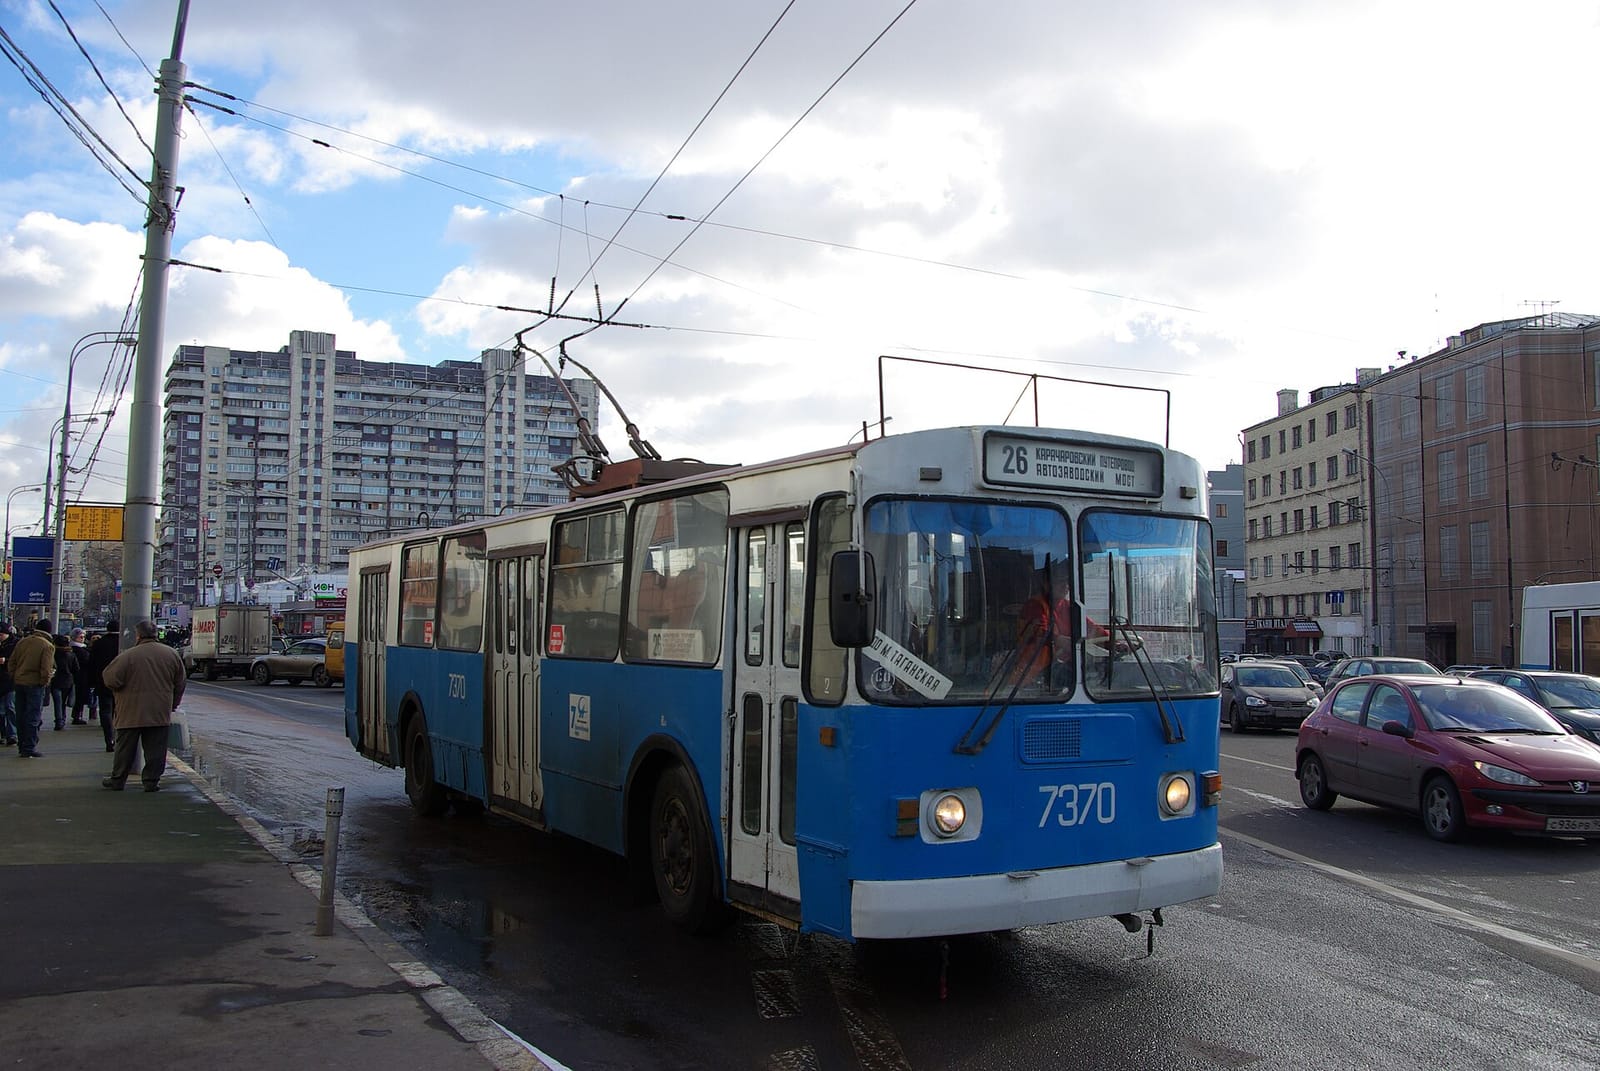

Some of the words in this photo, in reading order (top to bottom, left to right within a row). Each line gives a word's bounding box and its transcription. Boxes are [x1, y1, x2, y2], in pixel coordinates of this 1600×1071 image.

[1002, 445, 1028, 475] 26
[1035, 447, 1096, 467] КАРАЧАРОВСКИЙ
[1115, 472, 1135, 488] МОСТ
[449, 673, 466, 699] 7370
[890, 650, 940, 692] ТАГАНСКАЯ
[1038, 782, 1115, 828] 7370
